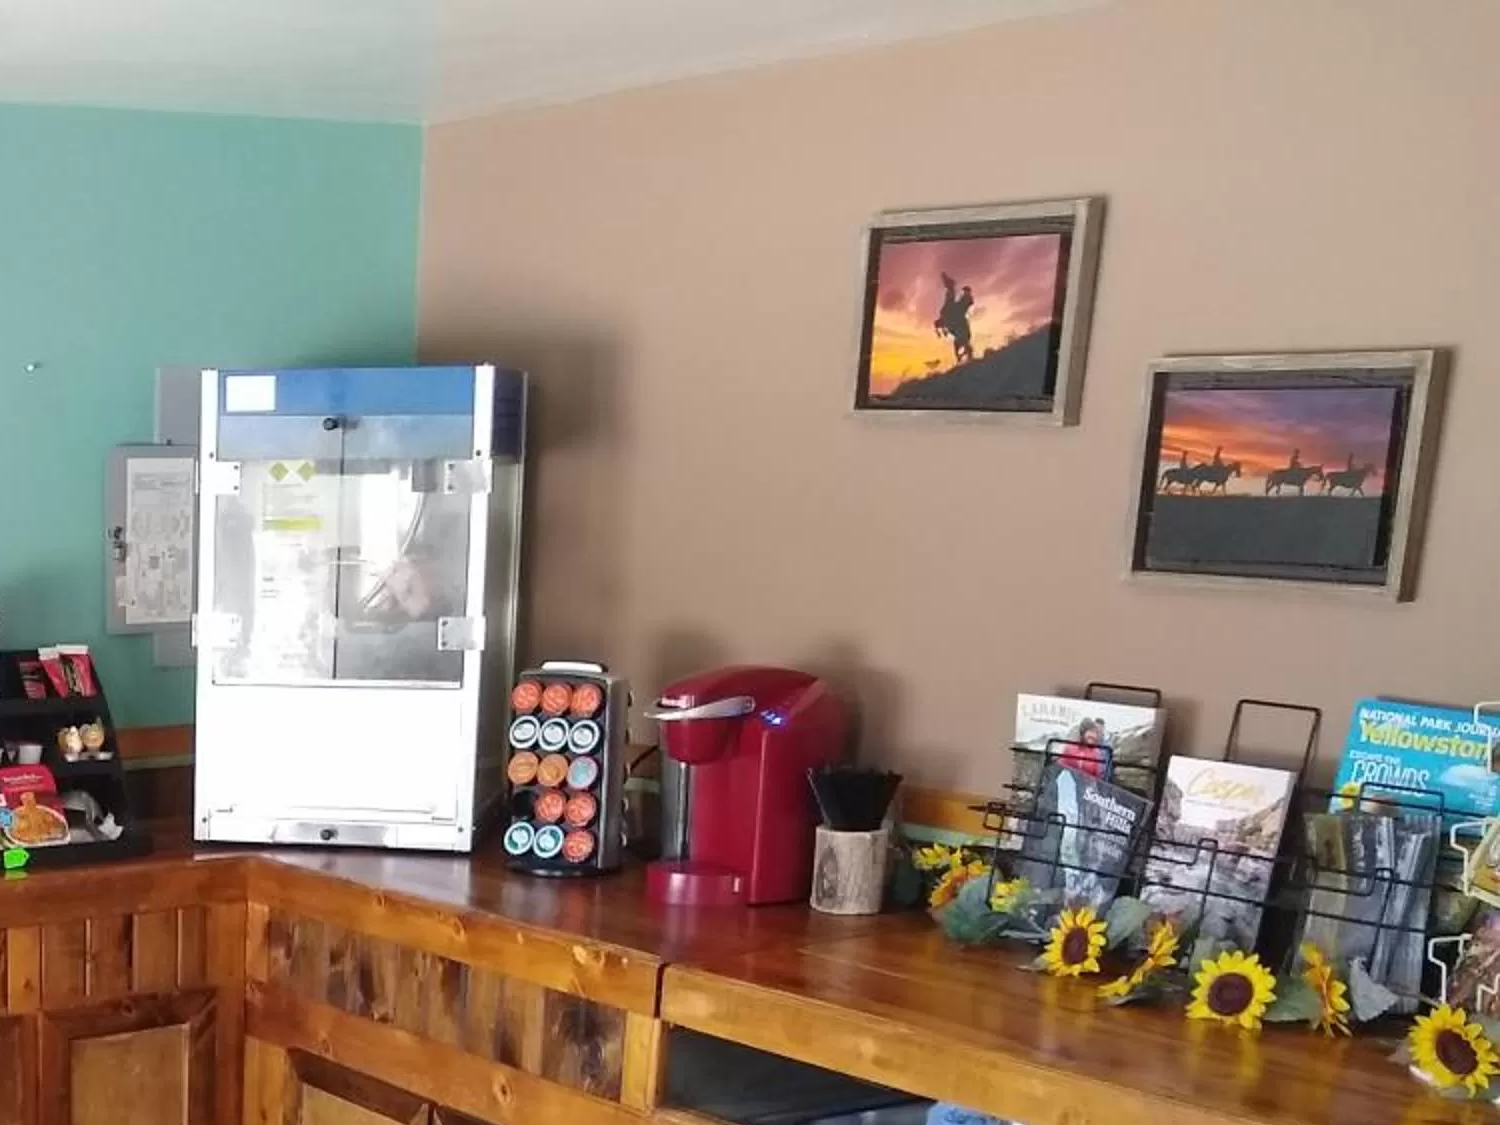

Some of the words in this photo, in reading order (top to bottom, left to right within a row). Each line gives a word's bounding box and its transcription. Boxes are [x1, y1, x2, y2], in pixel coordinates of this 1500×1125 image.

[1359, 708, 1417, 727] NATIONAL
[1420, 716, 1452, 731] PARK
[1454, 721, 1500, 737] JOURNA
[1360, 719, 1490, 761] Yellowston
[1351, 760, 1430, 797] CROWDS
[1083, 787, 1136, 821] Southern
